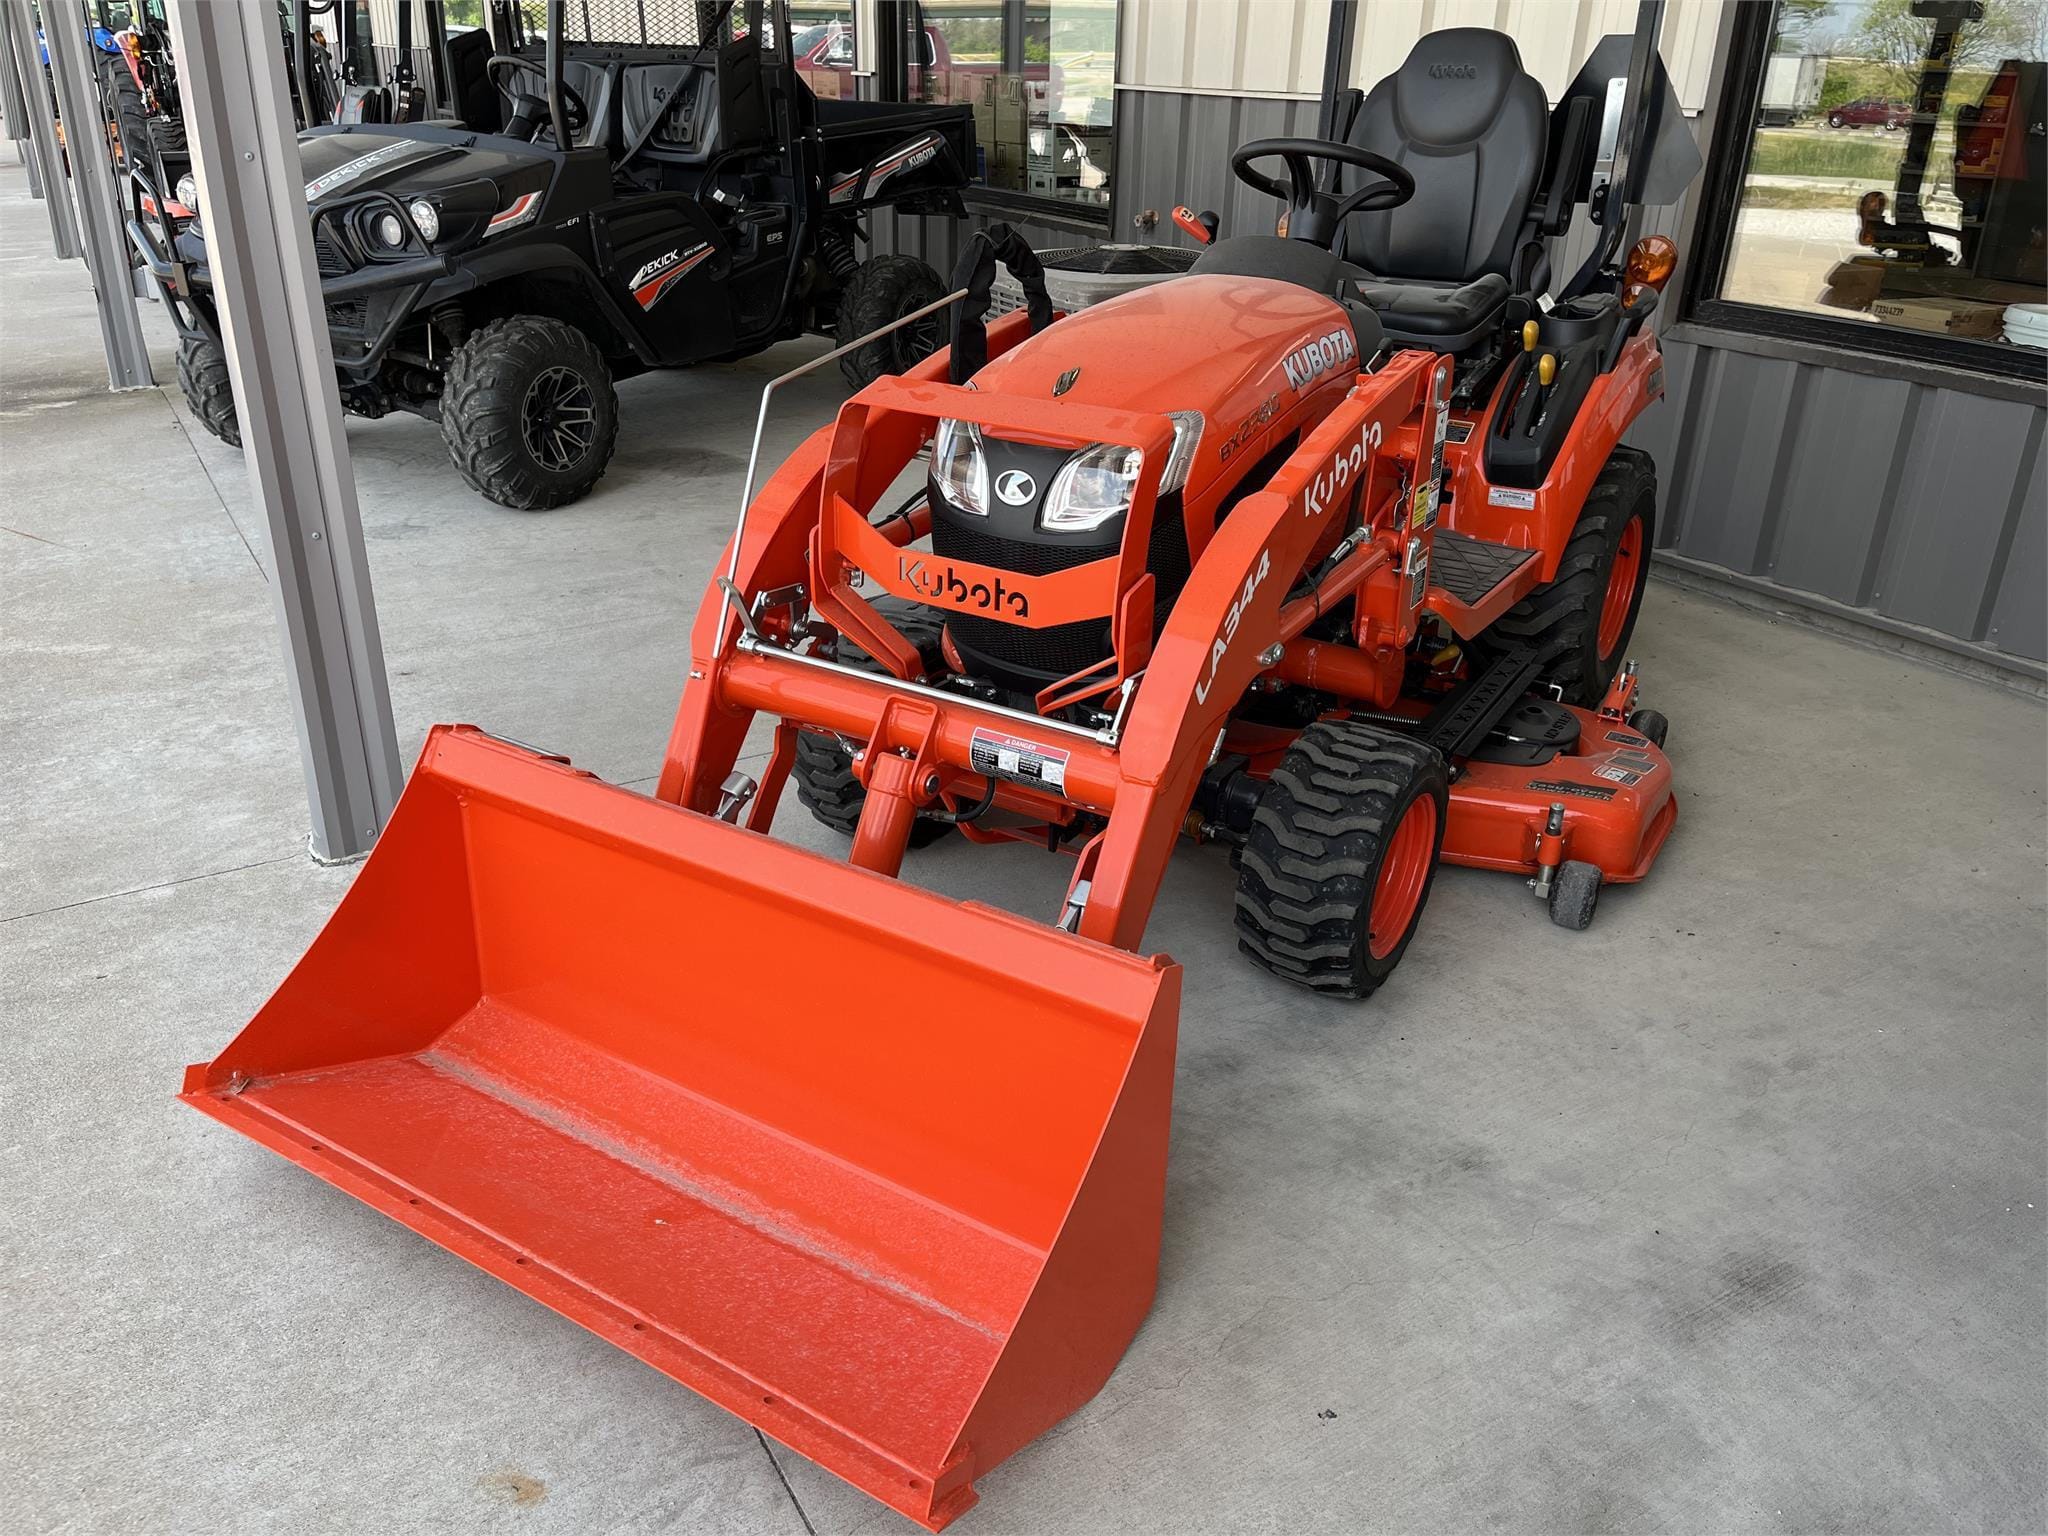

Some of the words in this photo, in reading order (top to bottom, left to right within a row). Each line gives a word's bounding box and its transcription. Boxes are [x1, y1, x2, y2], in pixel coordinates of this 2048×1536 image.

[907, 146, 937, 168] KUBOTA
[1281, 327, 1357, 392] KUBOTA
[1304, 421, 1382, 518] Kubota
[899, 556, 1029, 618] Kubota
[1195, 548, 1270, 706] LA344
[1011, 740, 1037, 752] DANGER
